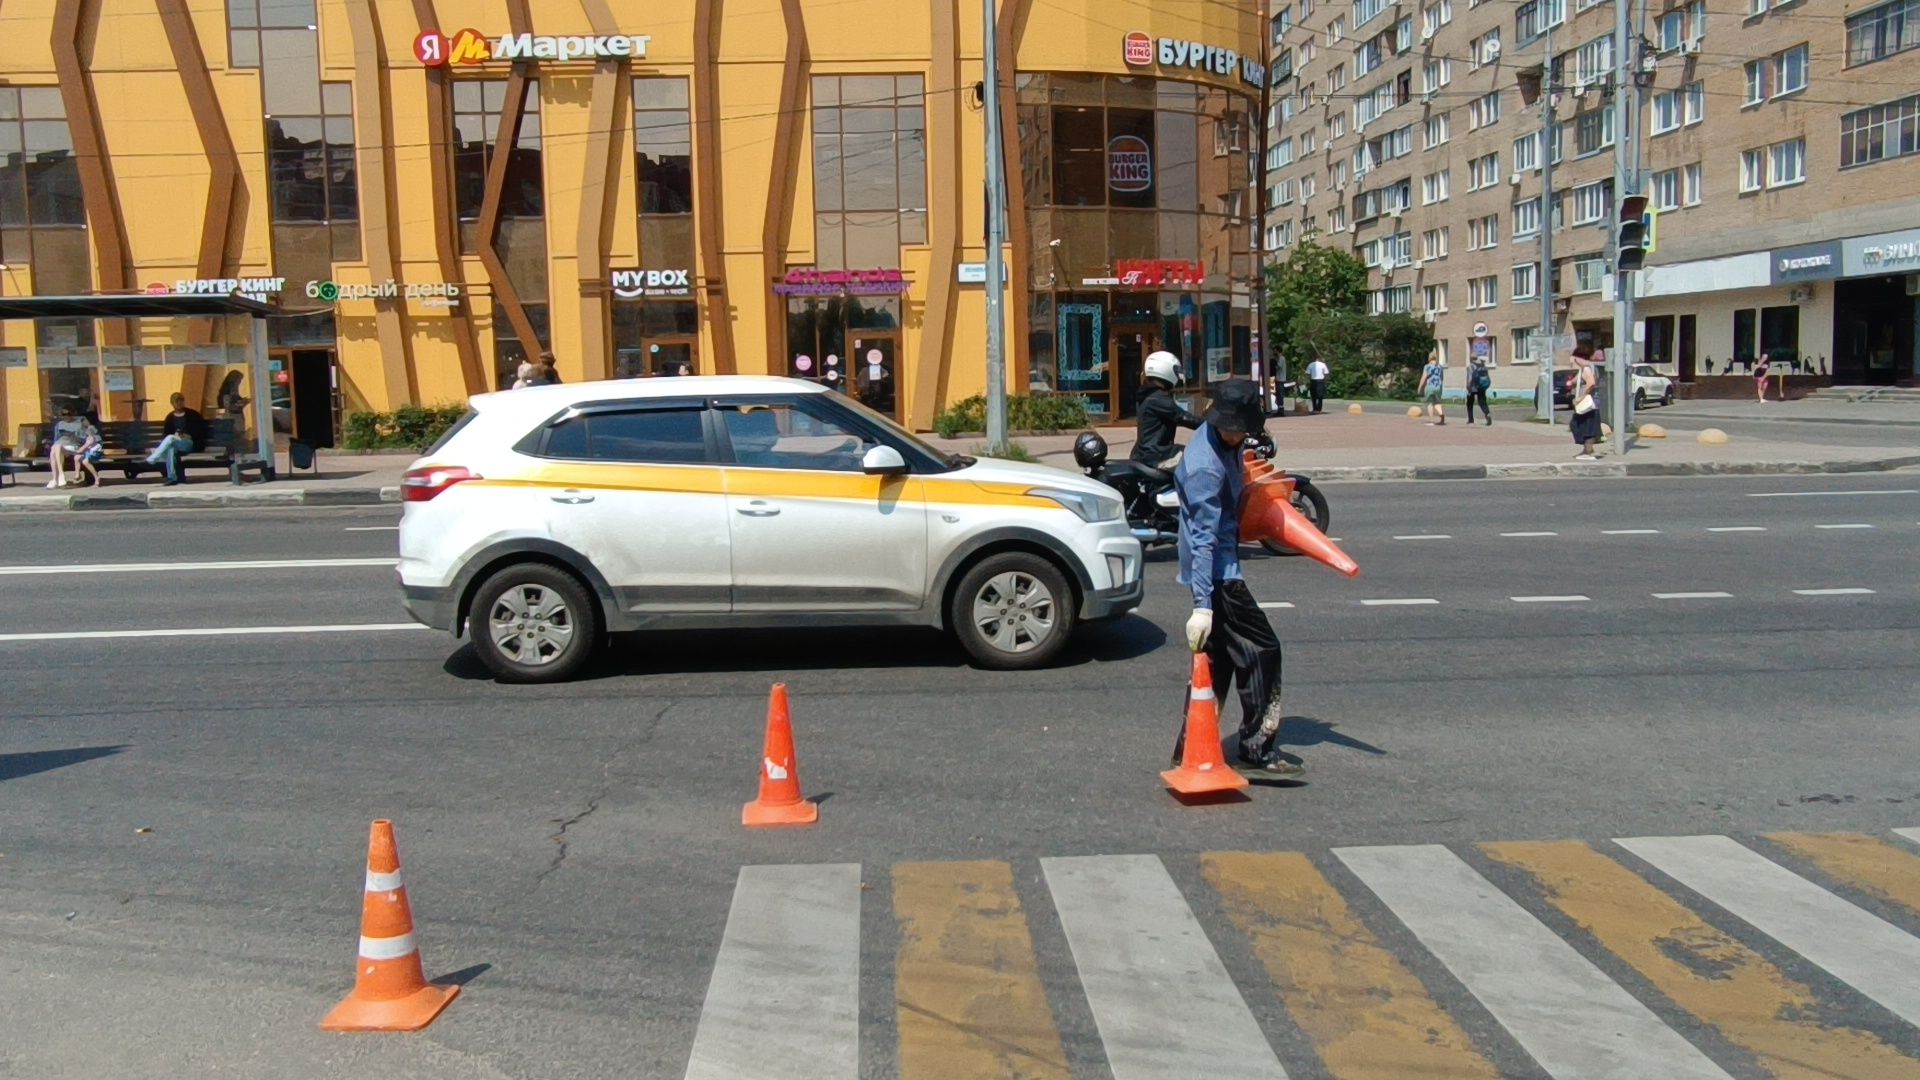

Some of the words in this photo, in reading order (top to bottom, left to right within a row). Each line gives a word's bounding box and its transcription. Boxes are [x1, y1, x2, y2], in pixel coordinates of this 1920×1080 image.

[421, 35, 439, 60] Я
[495, 33, 651, 60] Маркет
[1158, 37, 1238, 76] БУРГЕР
[1109, 164, 1149, 180] KING
[175, 279, 238, 294] БУРГЕР
[240, 277, 285, 292] КИНГ
[612, 270, 644, 287] MY
[647, 269, 688, 286] BOX
[404, 281, 459, 300] день
